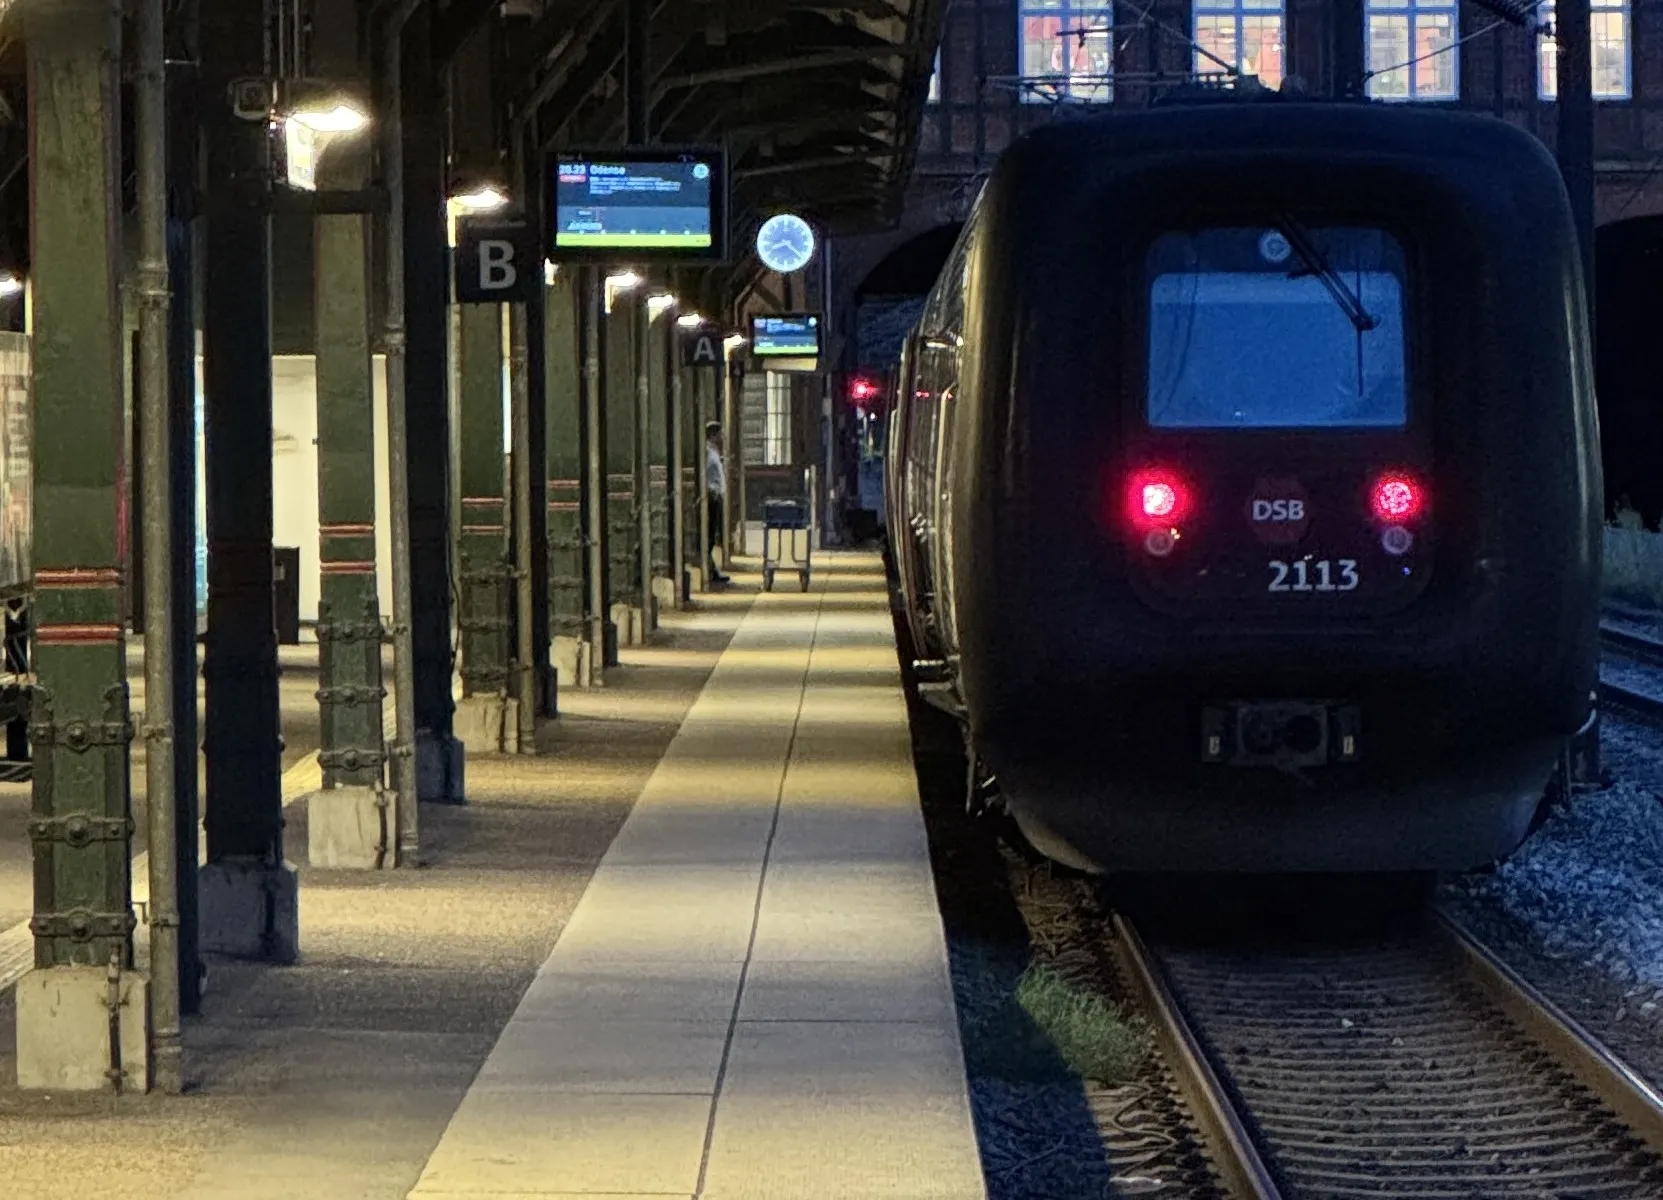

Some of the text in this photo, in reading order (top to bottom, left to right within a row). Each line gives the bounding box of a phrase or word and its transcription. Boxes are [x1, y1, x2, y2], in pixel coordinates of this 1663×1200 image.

[479, 240, 517, 289] B
[694, 336, 715, 361] A
[1252, 499, 1305, 520] DSB
[1268, 559, 1359, 591] 2113
